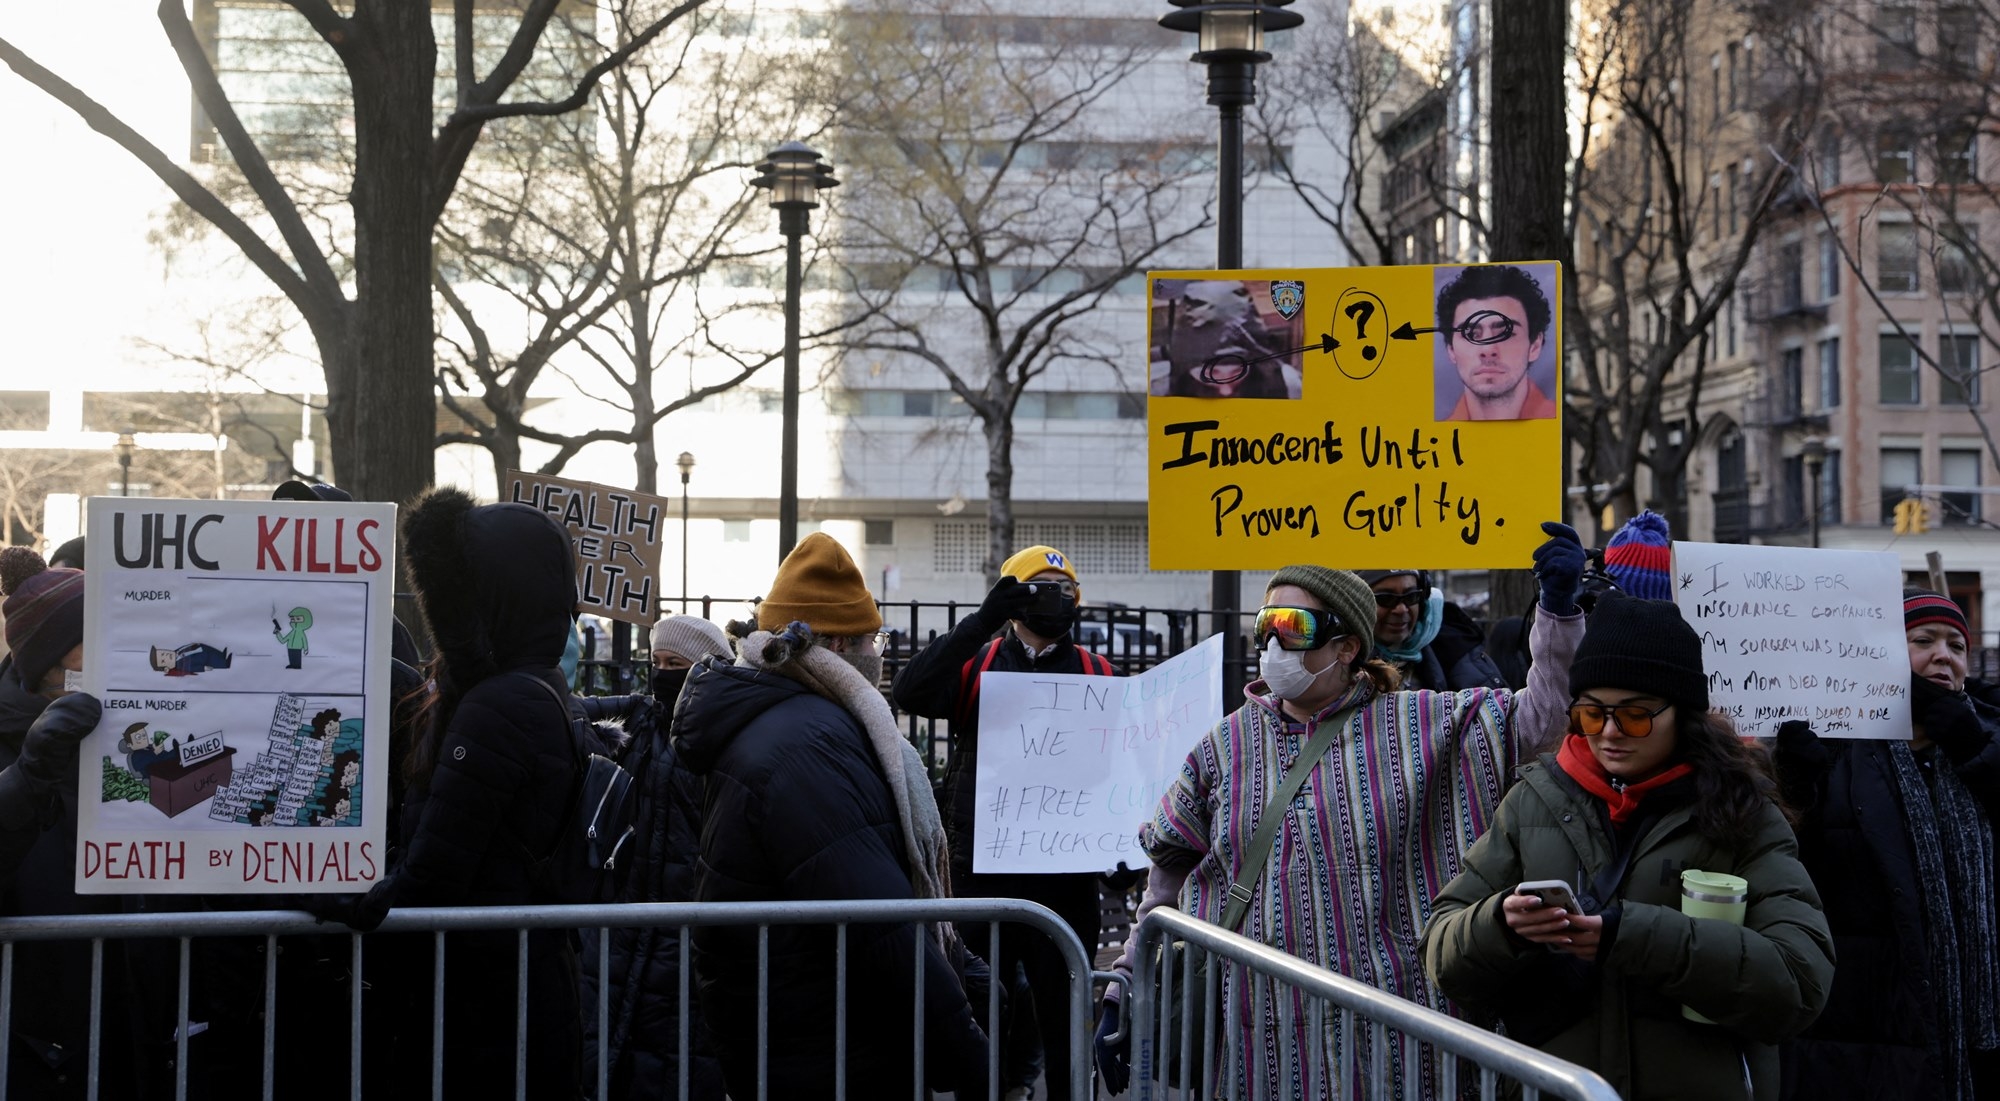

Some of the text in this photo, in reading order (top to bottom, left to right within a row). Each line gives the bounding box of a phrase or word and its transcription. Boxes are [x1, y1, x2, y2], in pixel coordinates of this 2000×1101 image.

[1344, 300, 1375, 361] ?
[1162, 420, 1464, 470] Innocent Until
[512, 480, 658, 543] HEALTH
[1211, 484, 1320, 538] Proven
[113, 512, 382, 574] UHC KILLS
[573, 537, 645, 567] ER
[1045, 553, 1064, 568] W
[124, 590, 171, 601] MURDER
[583, 565, 650, 614] LTH
[1743, 570, 1806, 592] WORKED
[1814, 573, 1849, 591] FOR
[1697, 600, 1798, 618] INSURANCE
[1739, 638, 1798, 655] SURGERY
[1802, 637, 1833, 654] WAS
[1029, 647, 1209, 712] IN LUIGI
[1788, 674, 1818, 690] DIED
[1862, 683, 1905, 699] SURGERY
[103, 699, 187, 711] LEGAL MURDER
[1754, 704, 1809, 720] INSURANCE
[1815, 705, 1851, 720] DENIED
[1857, 707, 1864, 719] A
[1869, 707, 1891, 720] ONE
[1020, 698, 1201, 759] WE TRUST
[1736, 722, 1764, 733] IGHT
[183, 738, 221, 760] DENIED
[989, 785, 1093, 822] #FREE
[84, 841, 377, 883] DEATH BY DENIALS
